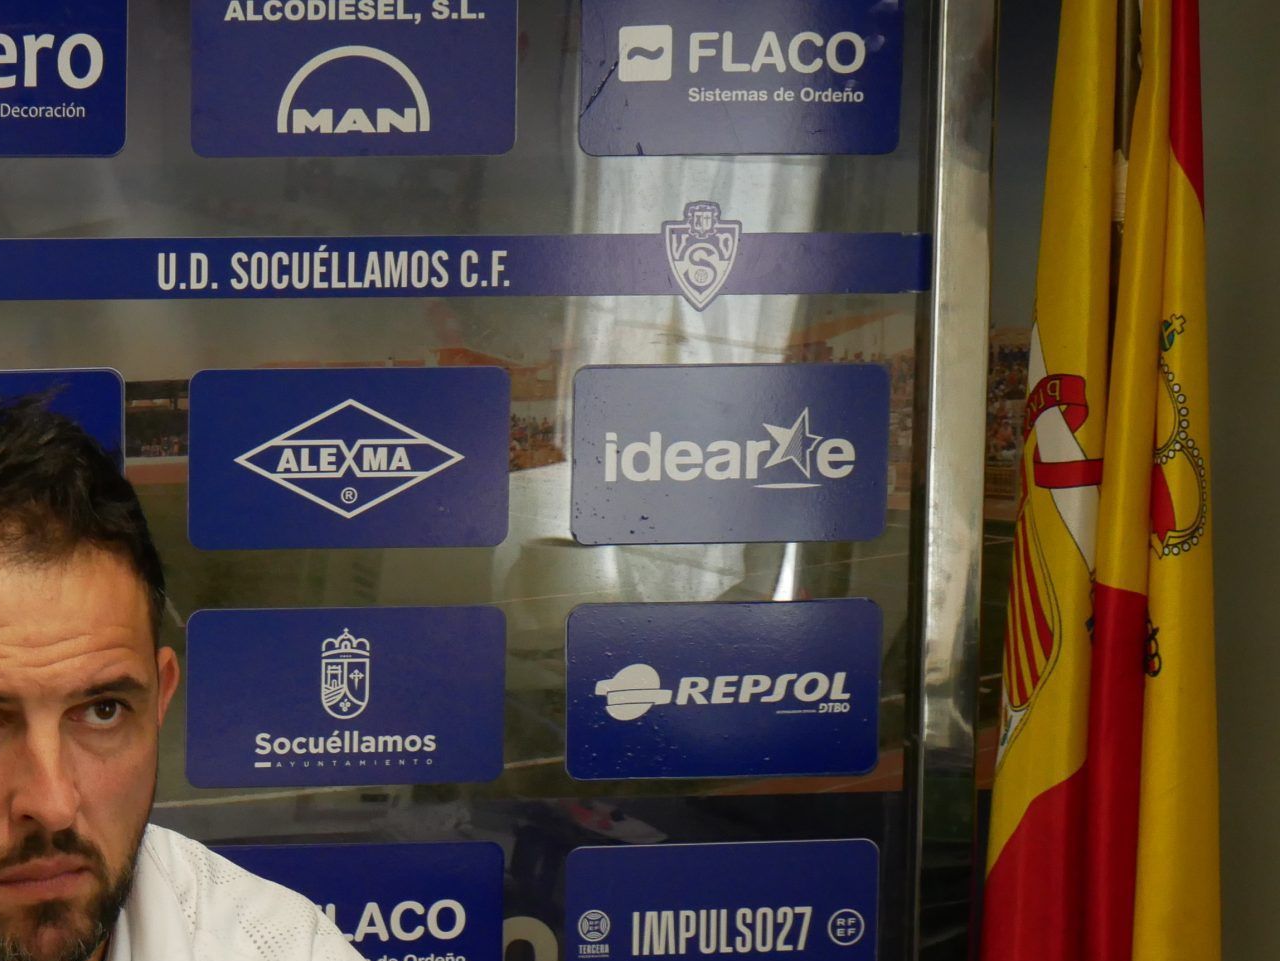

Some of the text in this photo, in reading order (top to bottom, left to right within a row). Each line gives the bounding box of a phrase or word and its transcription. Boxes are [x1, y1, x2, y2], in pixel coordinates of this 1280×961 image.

[224, 0, 485, 25] ALCODIESEL, S.L.
[689, 30, 866, 74] FLACO
[688, 87, 864, 103] Sistemas de Ordeño
[0, 102, 86, 119] Decoración
[292, 108, 417, 134] MAN
[157, 244, 510, 291] U.D. SOCUÉLLAMOS C.F.
[276, 445, 411, 473] ALEXMA
[675, 672, 851, 705] REPSOL
[254, 730, 437, 755] Socuéllamos
[276, 758, 433, 768] AYUNTAMIENTO
[631, 906, 813, 956] IMPULSO27
